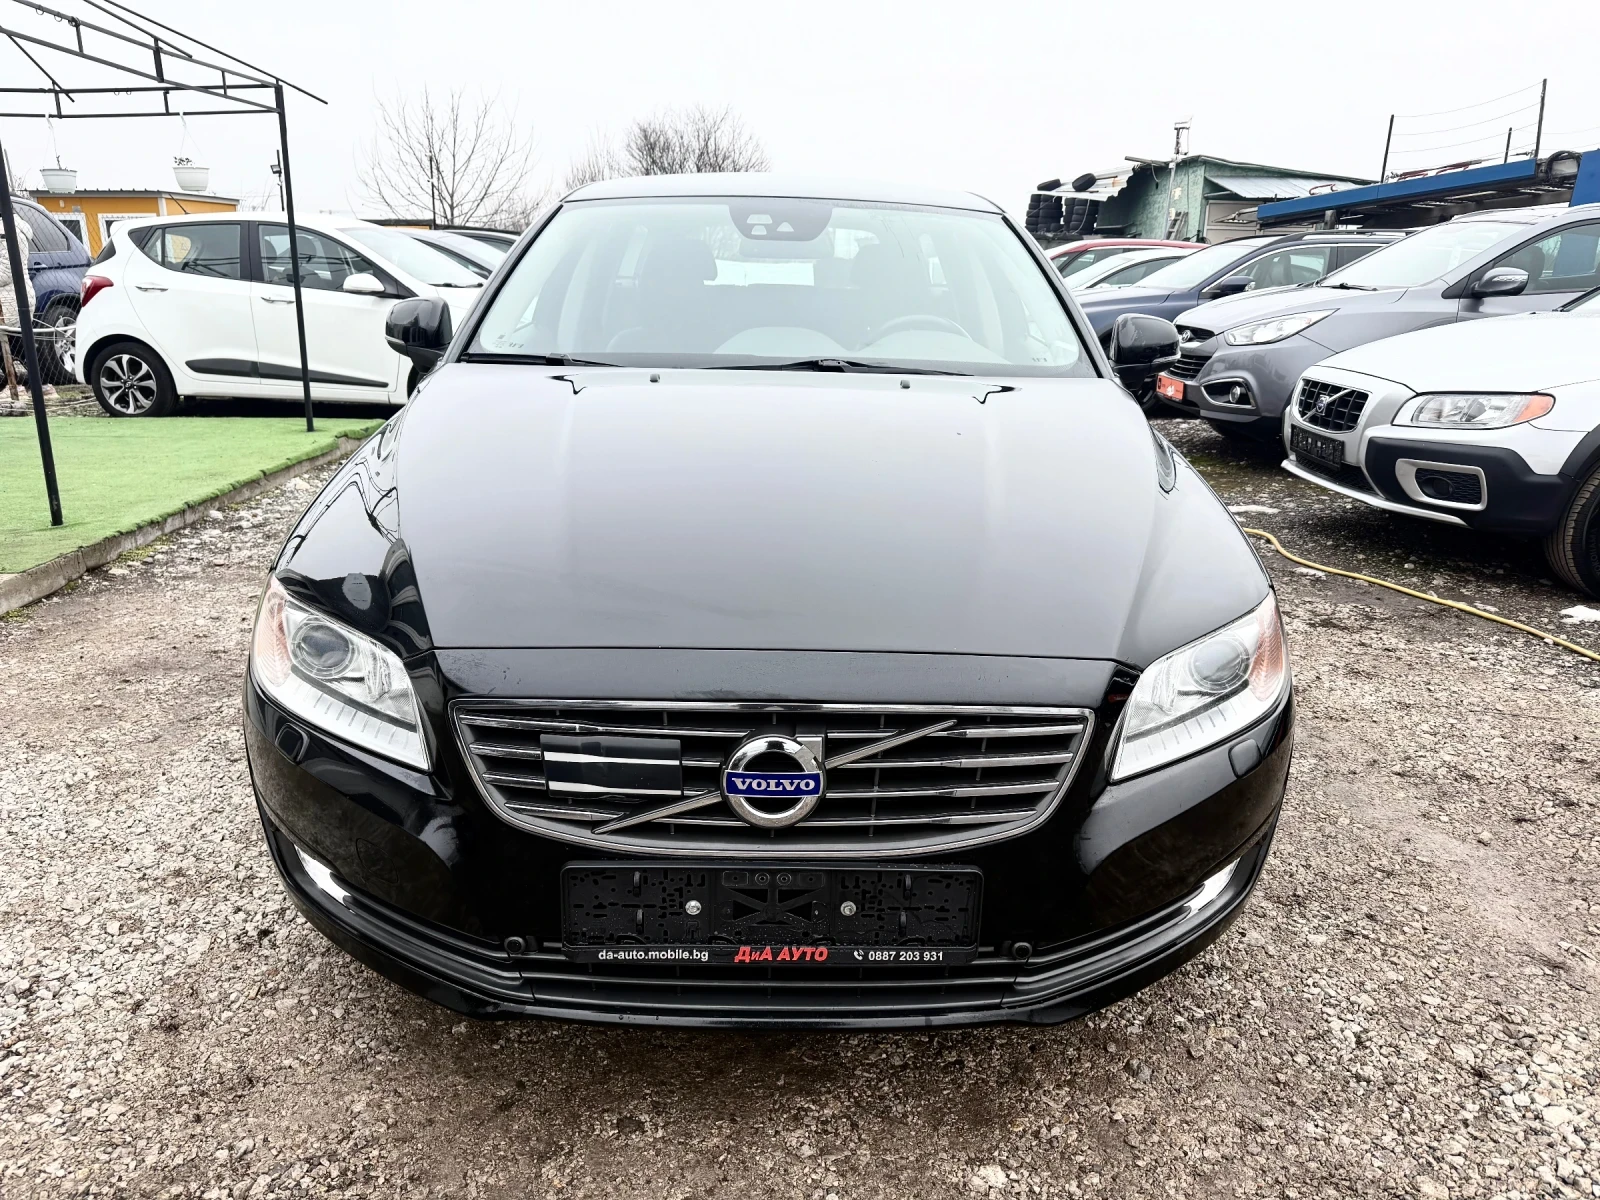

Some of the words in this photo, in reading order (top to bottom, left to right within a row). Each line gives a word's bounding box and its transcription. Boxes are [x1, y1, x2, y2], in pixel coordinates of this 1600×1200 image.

[732, 778, 815, 791] VOLVO
[598, 949, 709, 962] da-auto.mobile.bg
[734, 945, 773, 963] ДиА
[776, 945, 829, 962] АУТО
[868, 951, 897, 961] 0887
[899, 951, 920, 961] 203
[923, 951, 943, 961] 931
